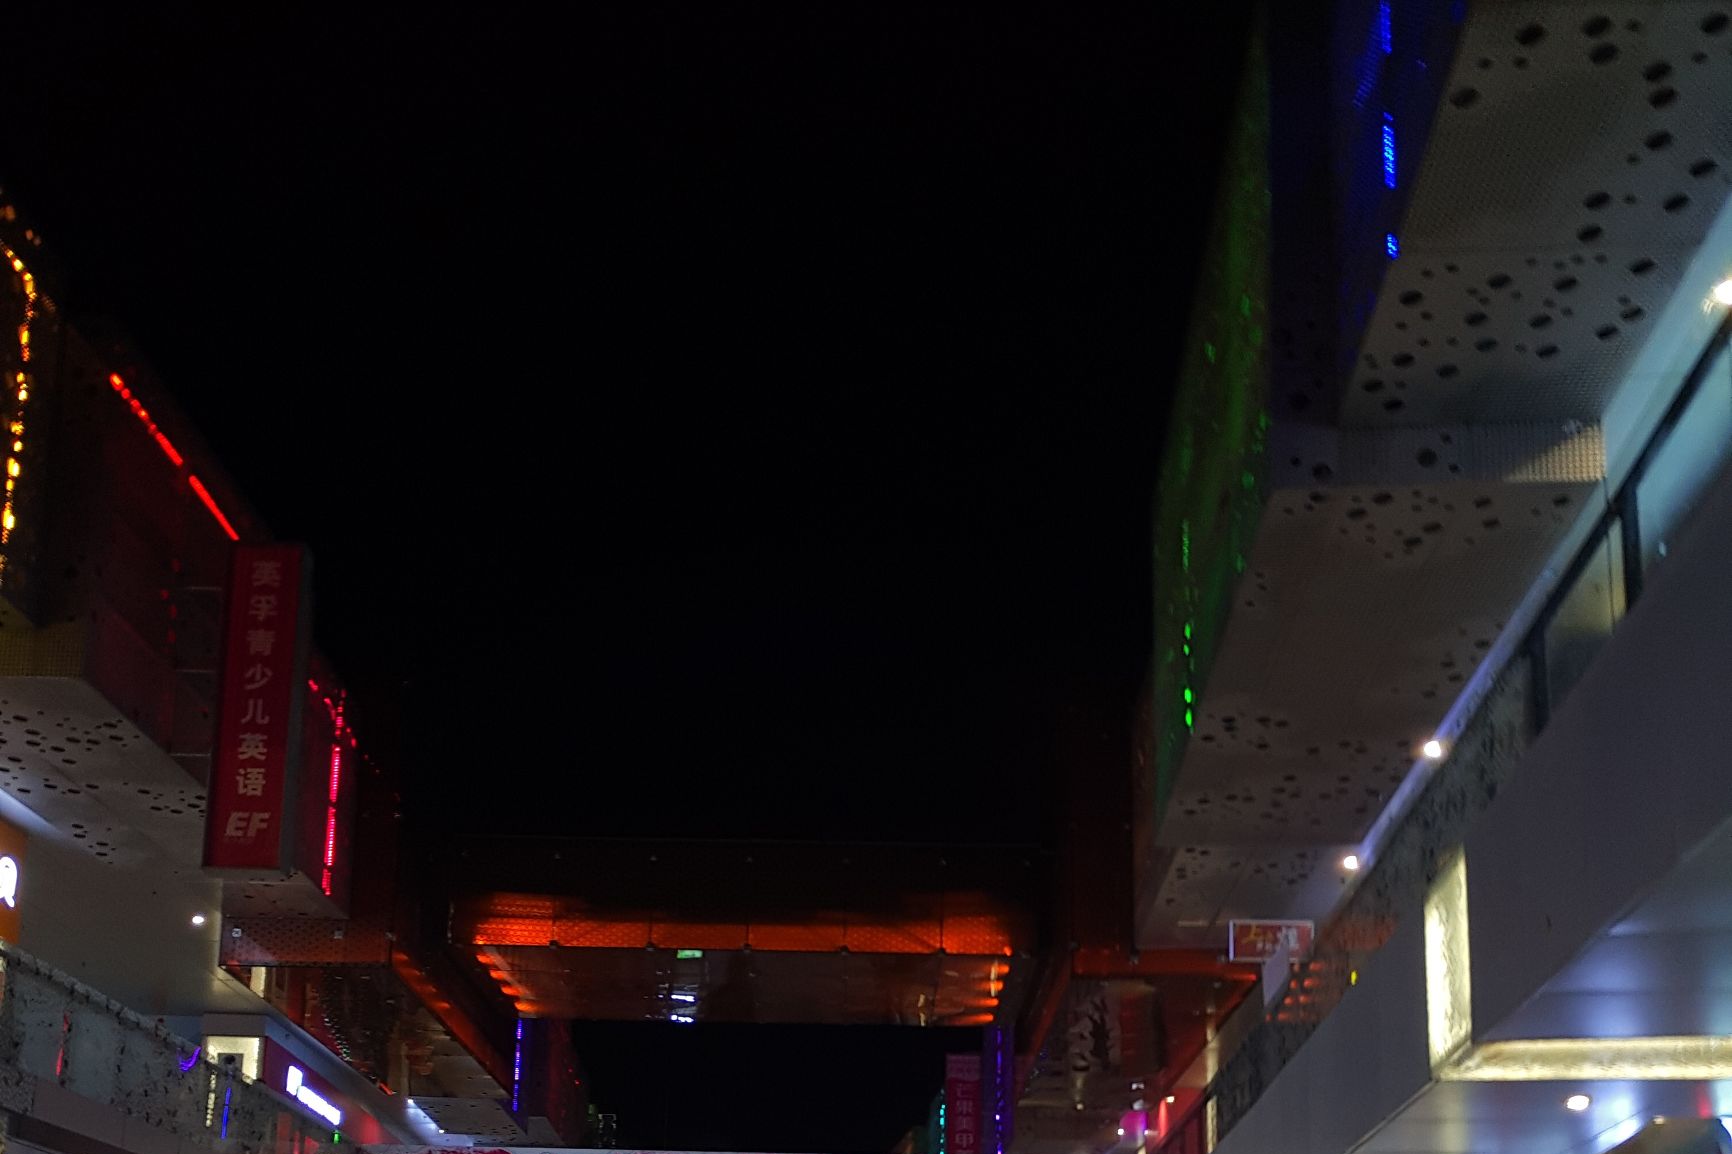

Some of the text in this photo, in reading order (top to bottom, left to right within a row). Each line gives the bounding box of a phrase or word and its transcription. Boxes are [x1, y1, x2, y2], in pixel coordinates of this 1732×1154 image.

[236, 560, 281, 797] 英孚青少儿英语
[224, 811, 271, 838] EF
